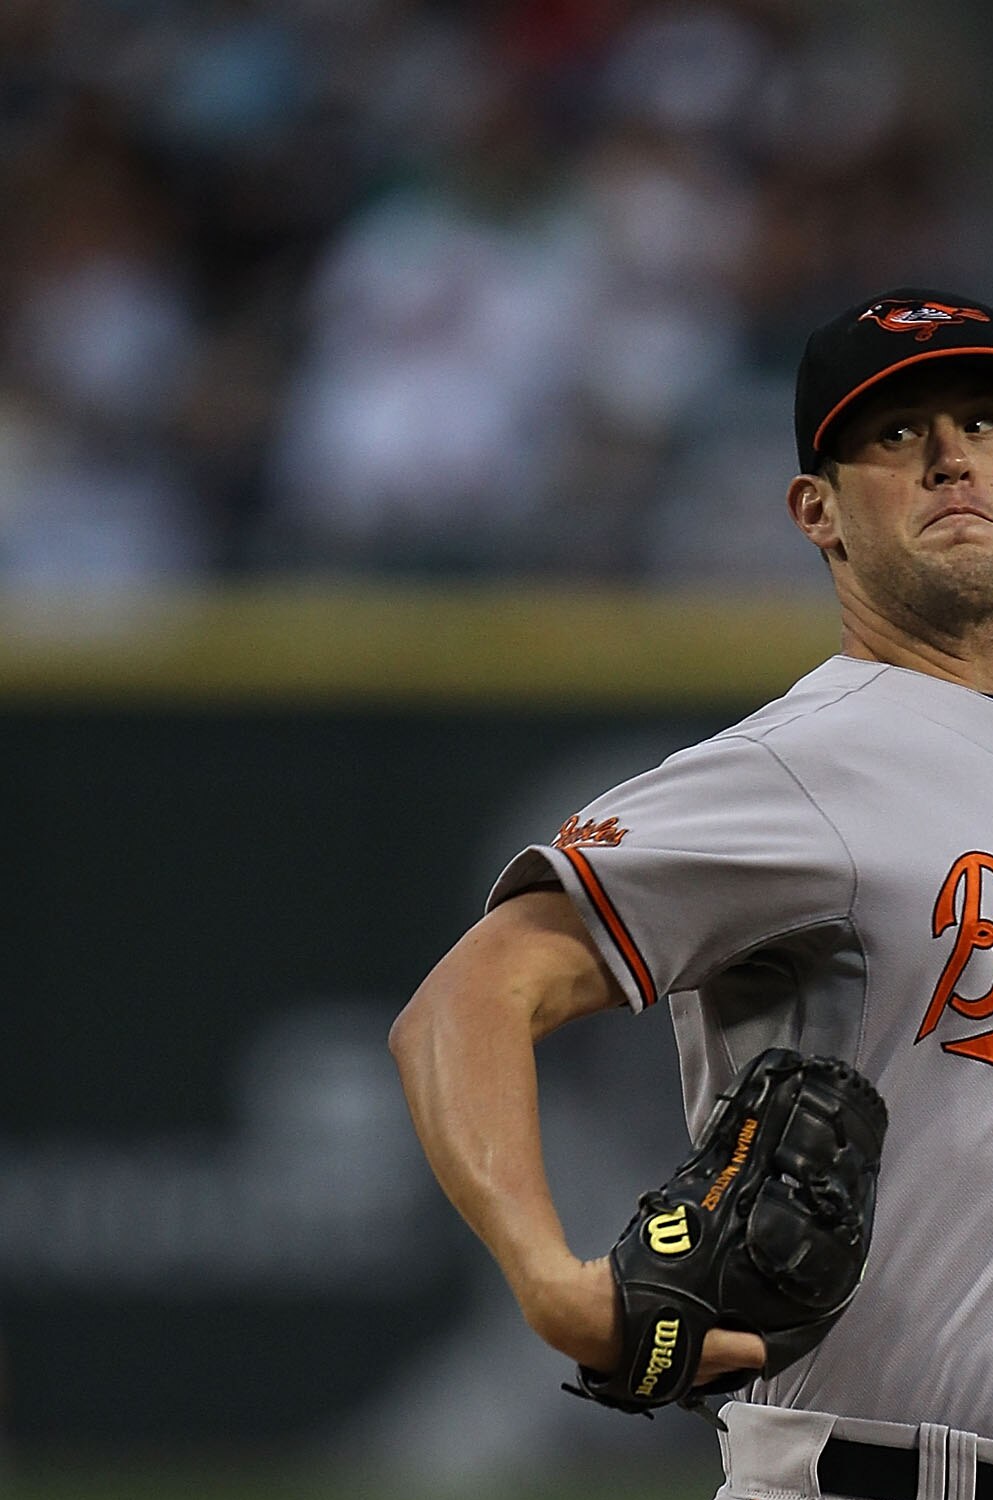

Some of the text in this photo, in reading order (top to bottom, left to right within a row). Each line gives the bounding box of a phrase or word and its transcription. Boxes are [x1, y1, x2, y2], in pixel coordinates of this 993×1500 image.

[731, 1118, 758, 1164] BRIAN
[648, 1205, 691, 1254] W
[635, 1319, 680, 1396] Wilson
